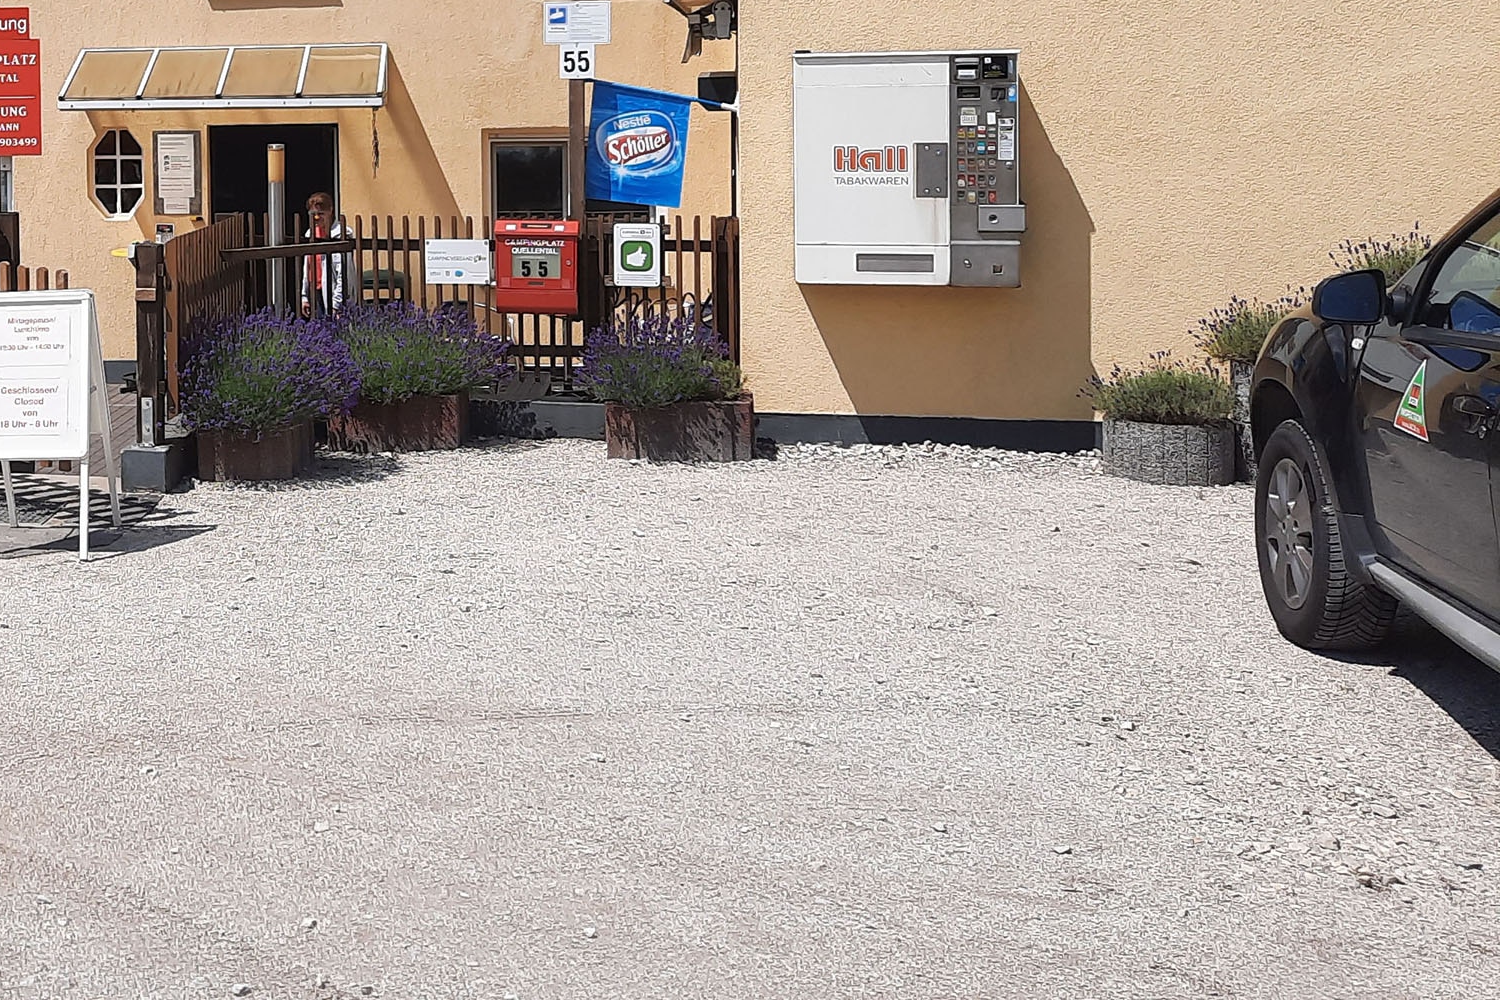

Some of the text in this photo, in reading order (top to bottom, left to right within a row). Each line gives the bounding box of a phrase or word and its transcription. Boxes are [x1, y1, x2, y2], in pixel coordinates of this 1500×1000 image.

[563, 50, 590, 73] 55
[608, 132, 668, 164] Schöller
[833, 145, 909, 173] Hall
[833, 176, 909, 186] TABAKWAREN
[504, 238, 565, 247] CAMPINGPLATZ
[0, 385, 59, 395] Geschlossen/
[0, 420, 10, 428] 18
[12, 420, 27, 428] Uhr
[35, 420, 41, 428] 8
[43, 420, 59, 428] Uhr
